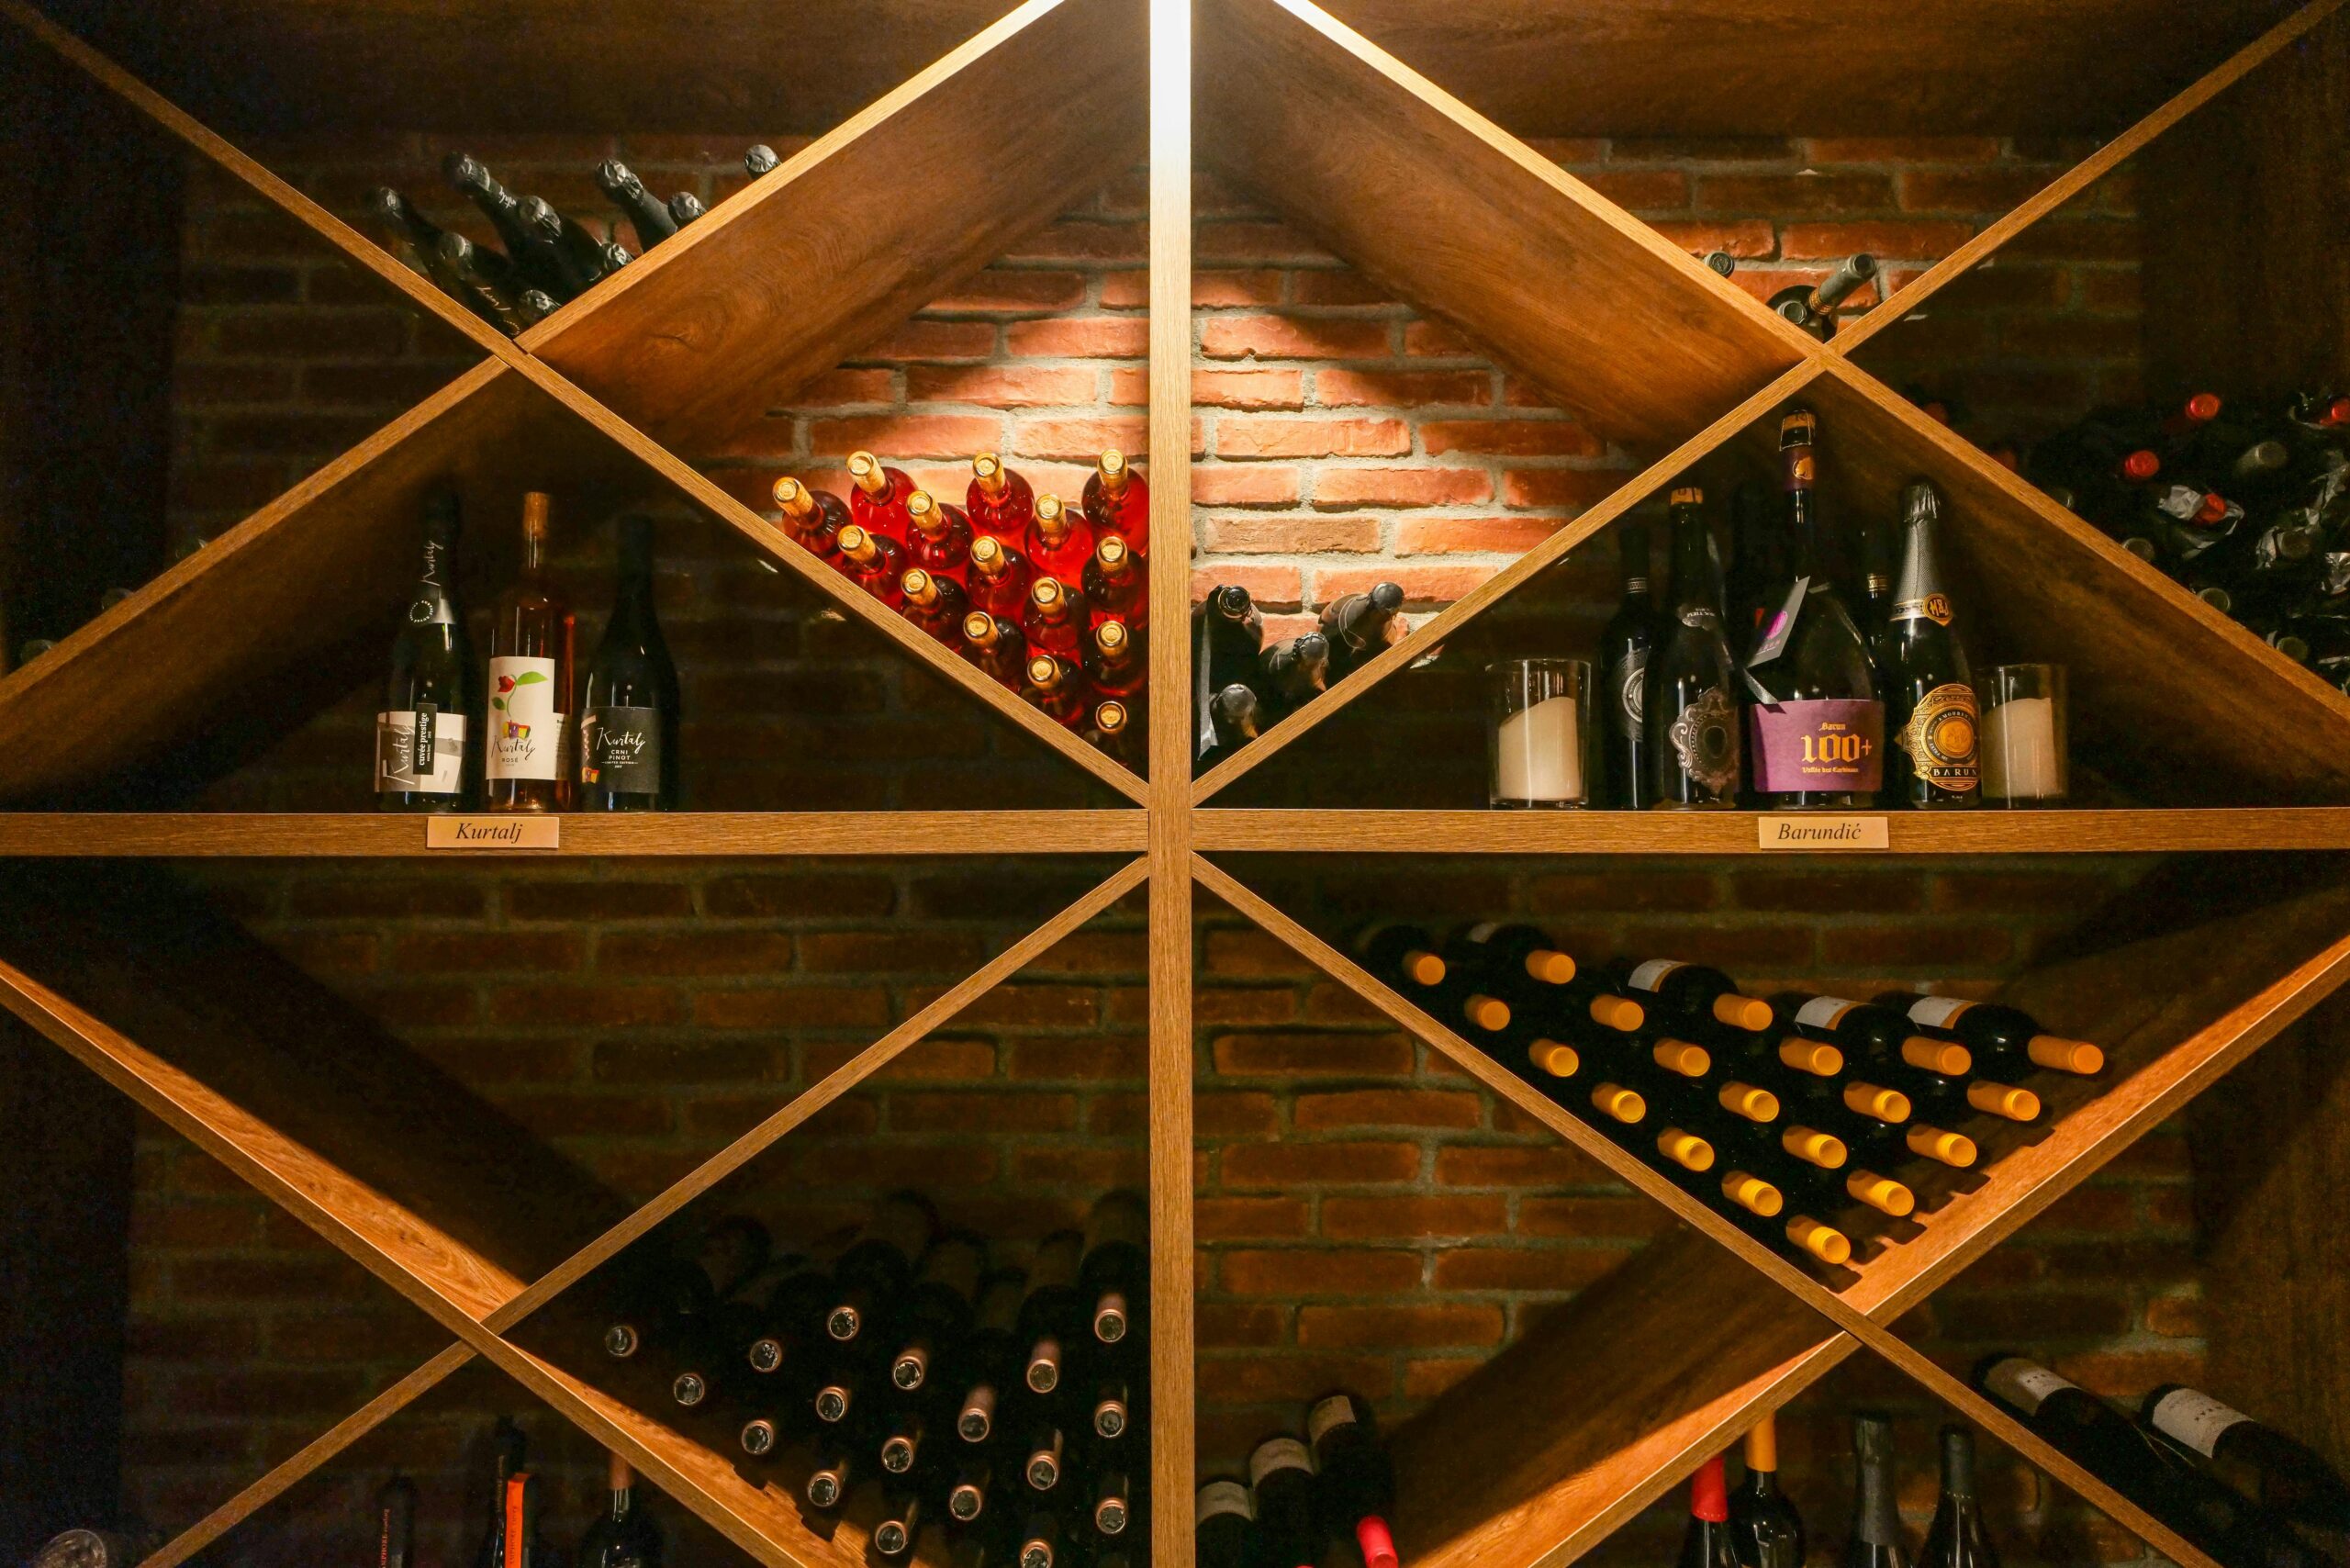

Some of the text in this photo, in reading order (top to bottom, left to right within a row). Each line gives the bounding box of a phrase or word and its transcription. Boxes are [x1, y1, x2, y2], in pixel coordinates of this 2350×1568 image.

[418, 712, 430, 766] cuvée prestige
[596, 726, 646, 755] Kurtalj
[1818, 722, 1847, 732] Barun
[383, 722, 415, 785] Kurtalj
[491, 735, 536, 761] Kurtalj
[1801, 734, 1873, 764] 100+
[455, 823, 523, 844] Kurtalj
[1777, 821, 1862, 842] Barundić
